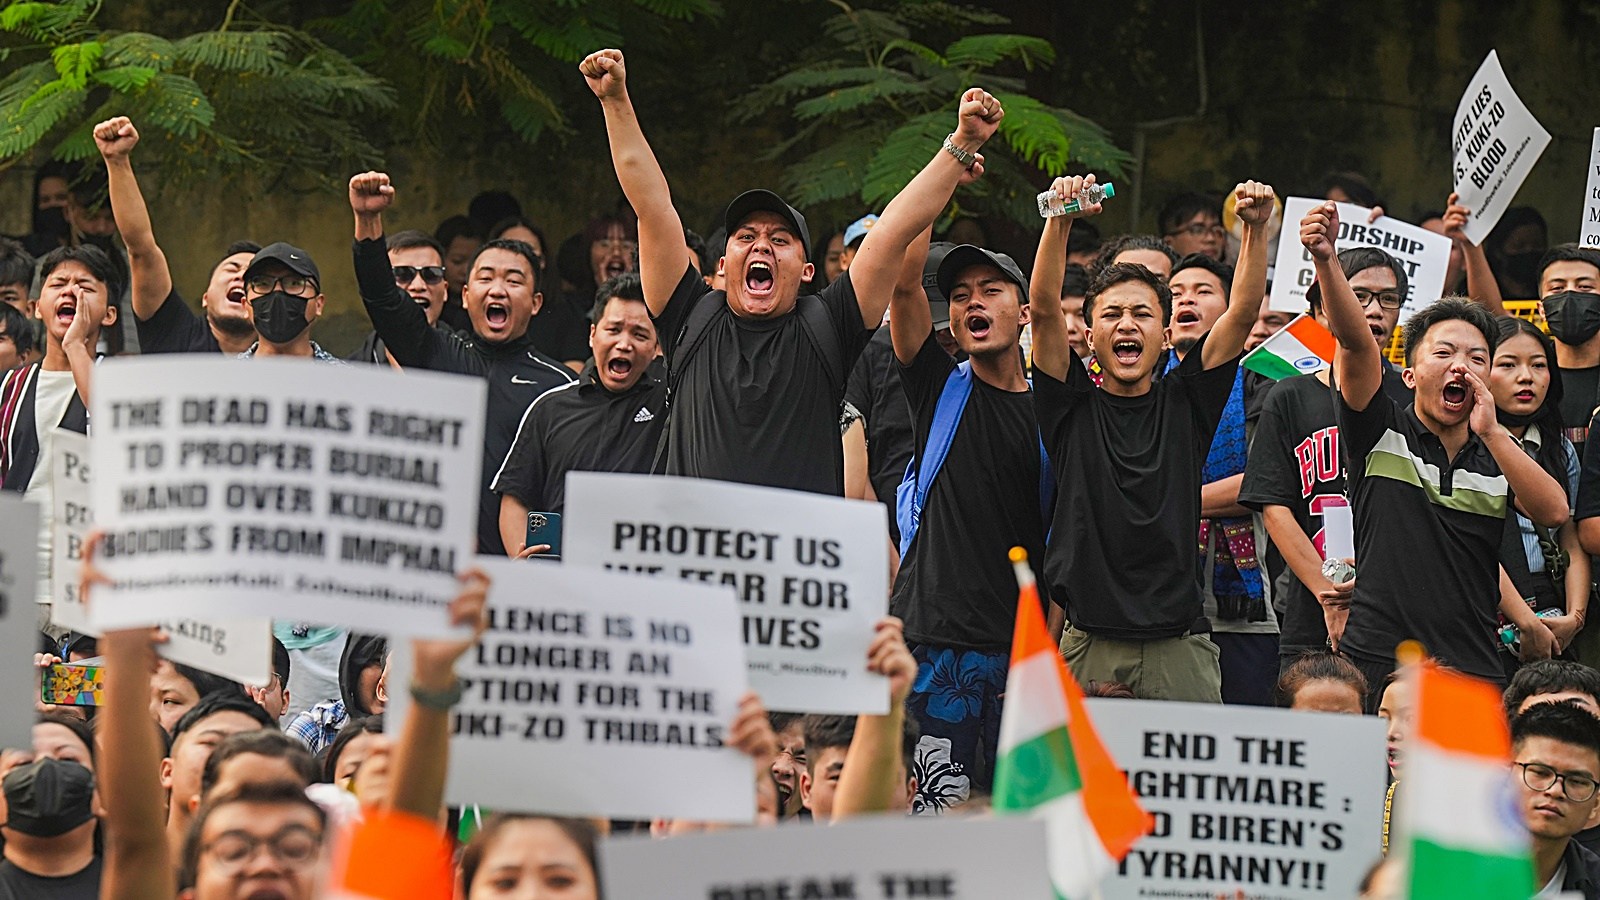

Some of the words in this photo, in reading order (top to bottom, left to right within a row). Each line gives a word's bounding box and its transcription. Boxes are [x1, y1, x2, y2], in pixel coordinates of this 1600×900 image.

[1455, 114, 1473, 152] EITEI
[1471, 84, 1492, 120] LIES
[1465, 101, 1505, 163] KUKI-ZO
[1471, 138, 1507, 190] BLOOD
[1337, 221, 1424, 255] ORSHIP
[111, 401, 161, 428] THE
[181, 399, 269, 425] DEAD
[285, 402, 352, 431] HAS
[368, 410, 464, 446] RIGHT
[127, 442, 164, 470] TO
[180, 441, 313, 470] PROPER
[329, 448, 441, 487] BURIAL
[119, 484, 208, 513] HAND
[226, 484, 313, 511] OVER
[329, 491, 444, 530] KUKIZO
[230, 526, 325, 556] FROM
[340, 535, 456, 574] IMPHAL
[614, 523, 779, 562] PROTECT
[795, 537, 841, 568] US
[782, 577, 848, 609] FOR
[487, 608, 588, 635] LENCE
[605, 616, 633, 639] IS
[649, 621, 691, 645] NO
[742, 616, 820, 650] IVES
[477, 644, 611, 672] LONGER
[627, 652, 671, 676] AN
[462, 679, 561, 705] TION
[577, 683, 640, 708] FOR
[657, 688, 714, 713] THE
[454, 714, 565, 740] KI-ZO
[585, 719, 724, 748] TRIBALS
[1143, 731, 1216, 760] END
[1235, 736, 1307, 768] THE
[1124, 770, 1326, 810] GHTMARE
[1190, 812, 1343, 851] BIREN'S
[879, 873, 954, 898] THE
[1118, 850, 1326, 890] TYRANNY!!
